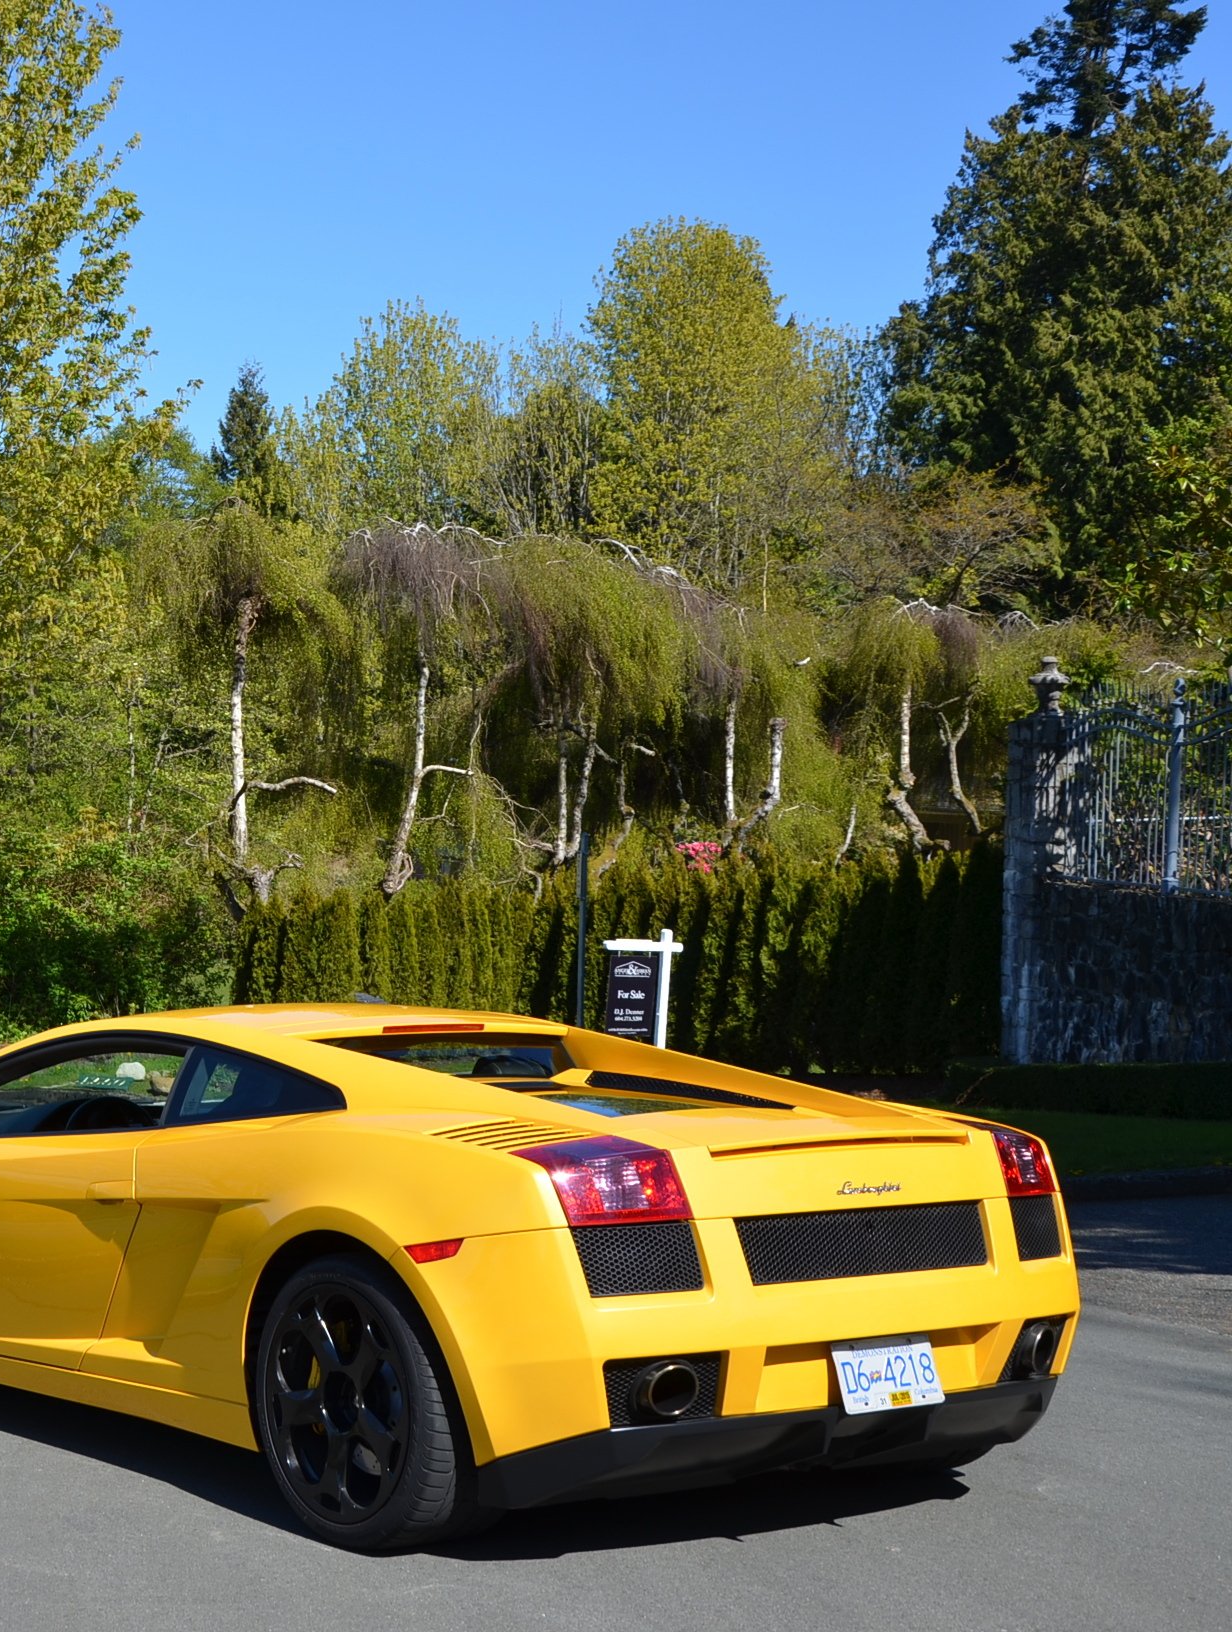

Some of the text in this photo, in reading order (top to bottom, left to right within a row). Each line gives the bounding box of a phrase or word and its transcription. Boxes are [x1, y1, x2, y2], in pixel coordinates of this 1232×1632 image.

[617, 989, 646, 999] For Sale
[836, 1181, 902, 1196] Lamborghini
[852, 1345, 913, 1359] DEMONSTRATION
[880, 1397, 887, 1406] 31
